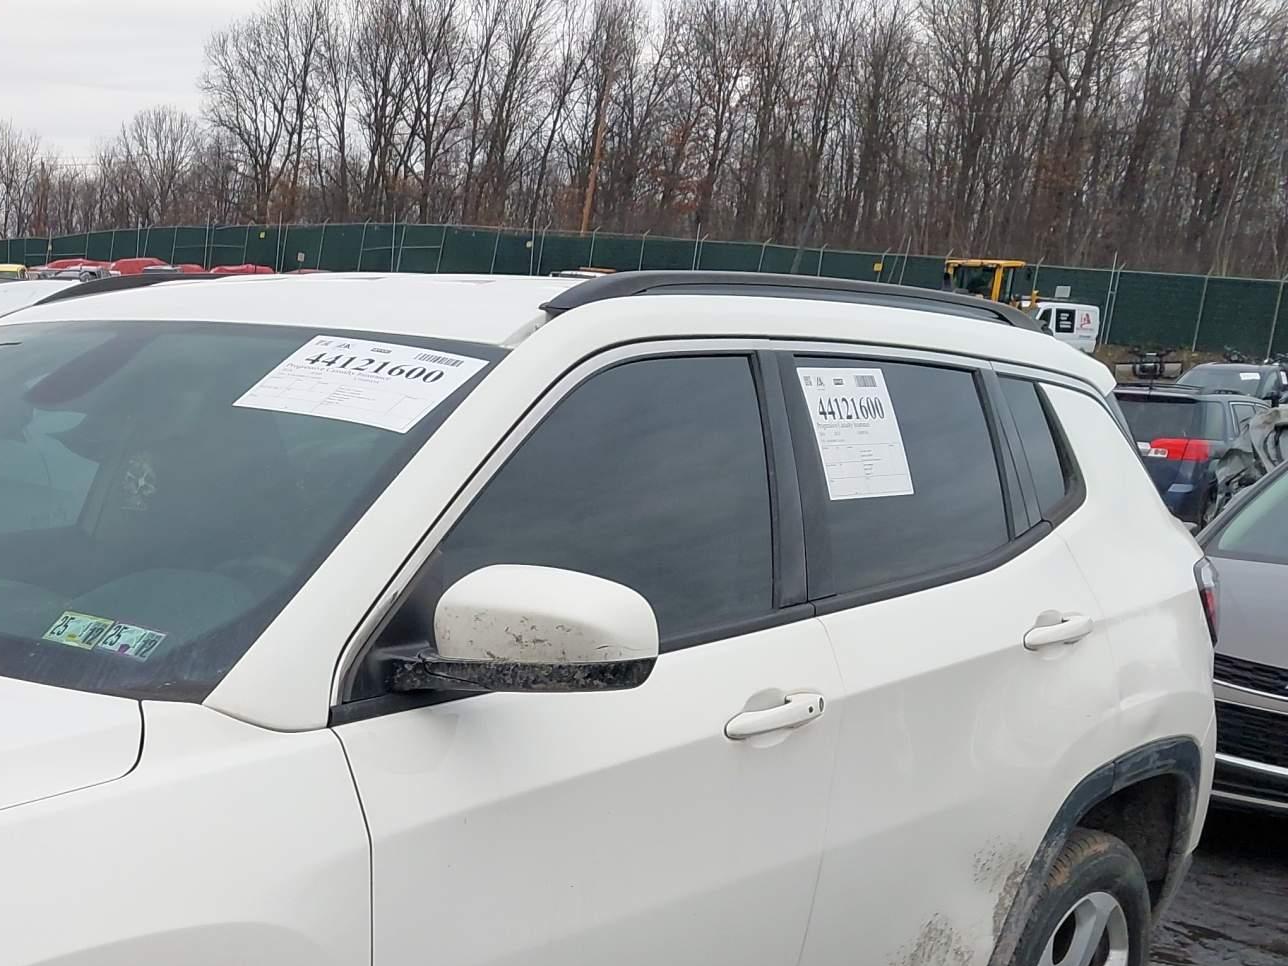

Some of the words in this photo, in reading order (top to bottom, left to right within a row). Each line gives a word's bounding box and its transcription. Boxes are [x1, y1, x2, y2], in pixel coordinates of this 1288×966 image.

[305, 352, 445, 384] 44121600
[818, 397, 885, 420] 44121600
[50, 615, 76, 636] 25
[103, 625, 128, 646] 25
